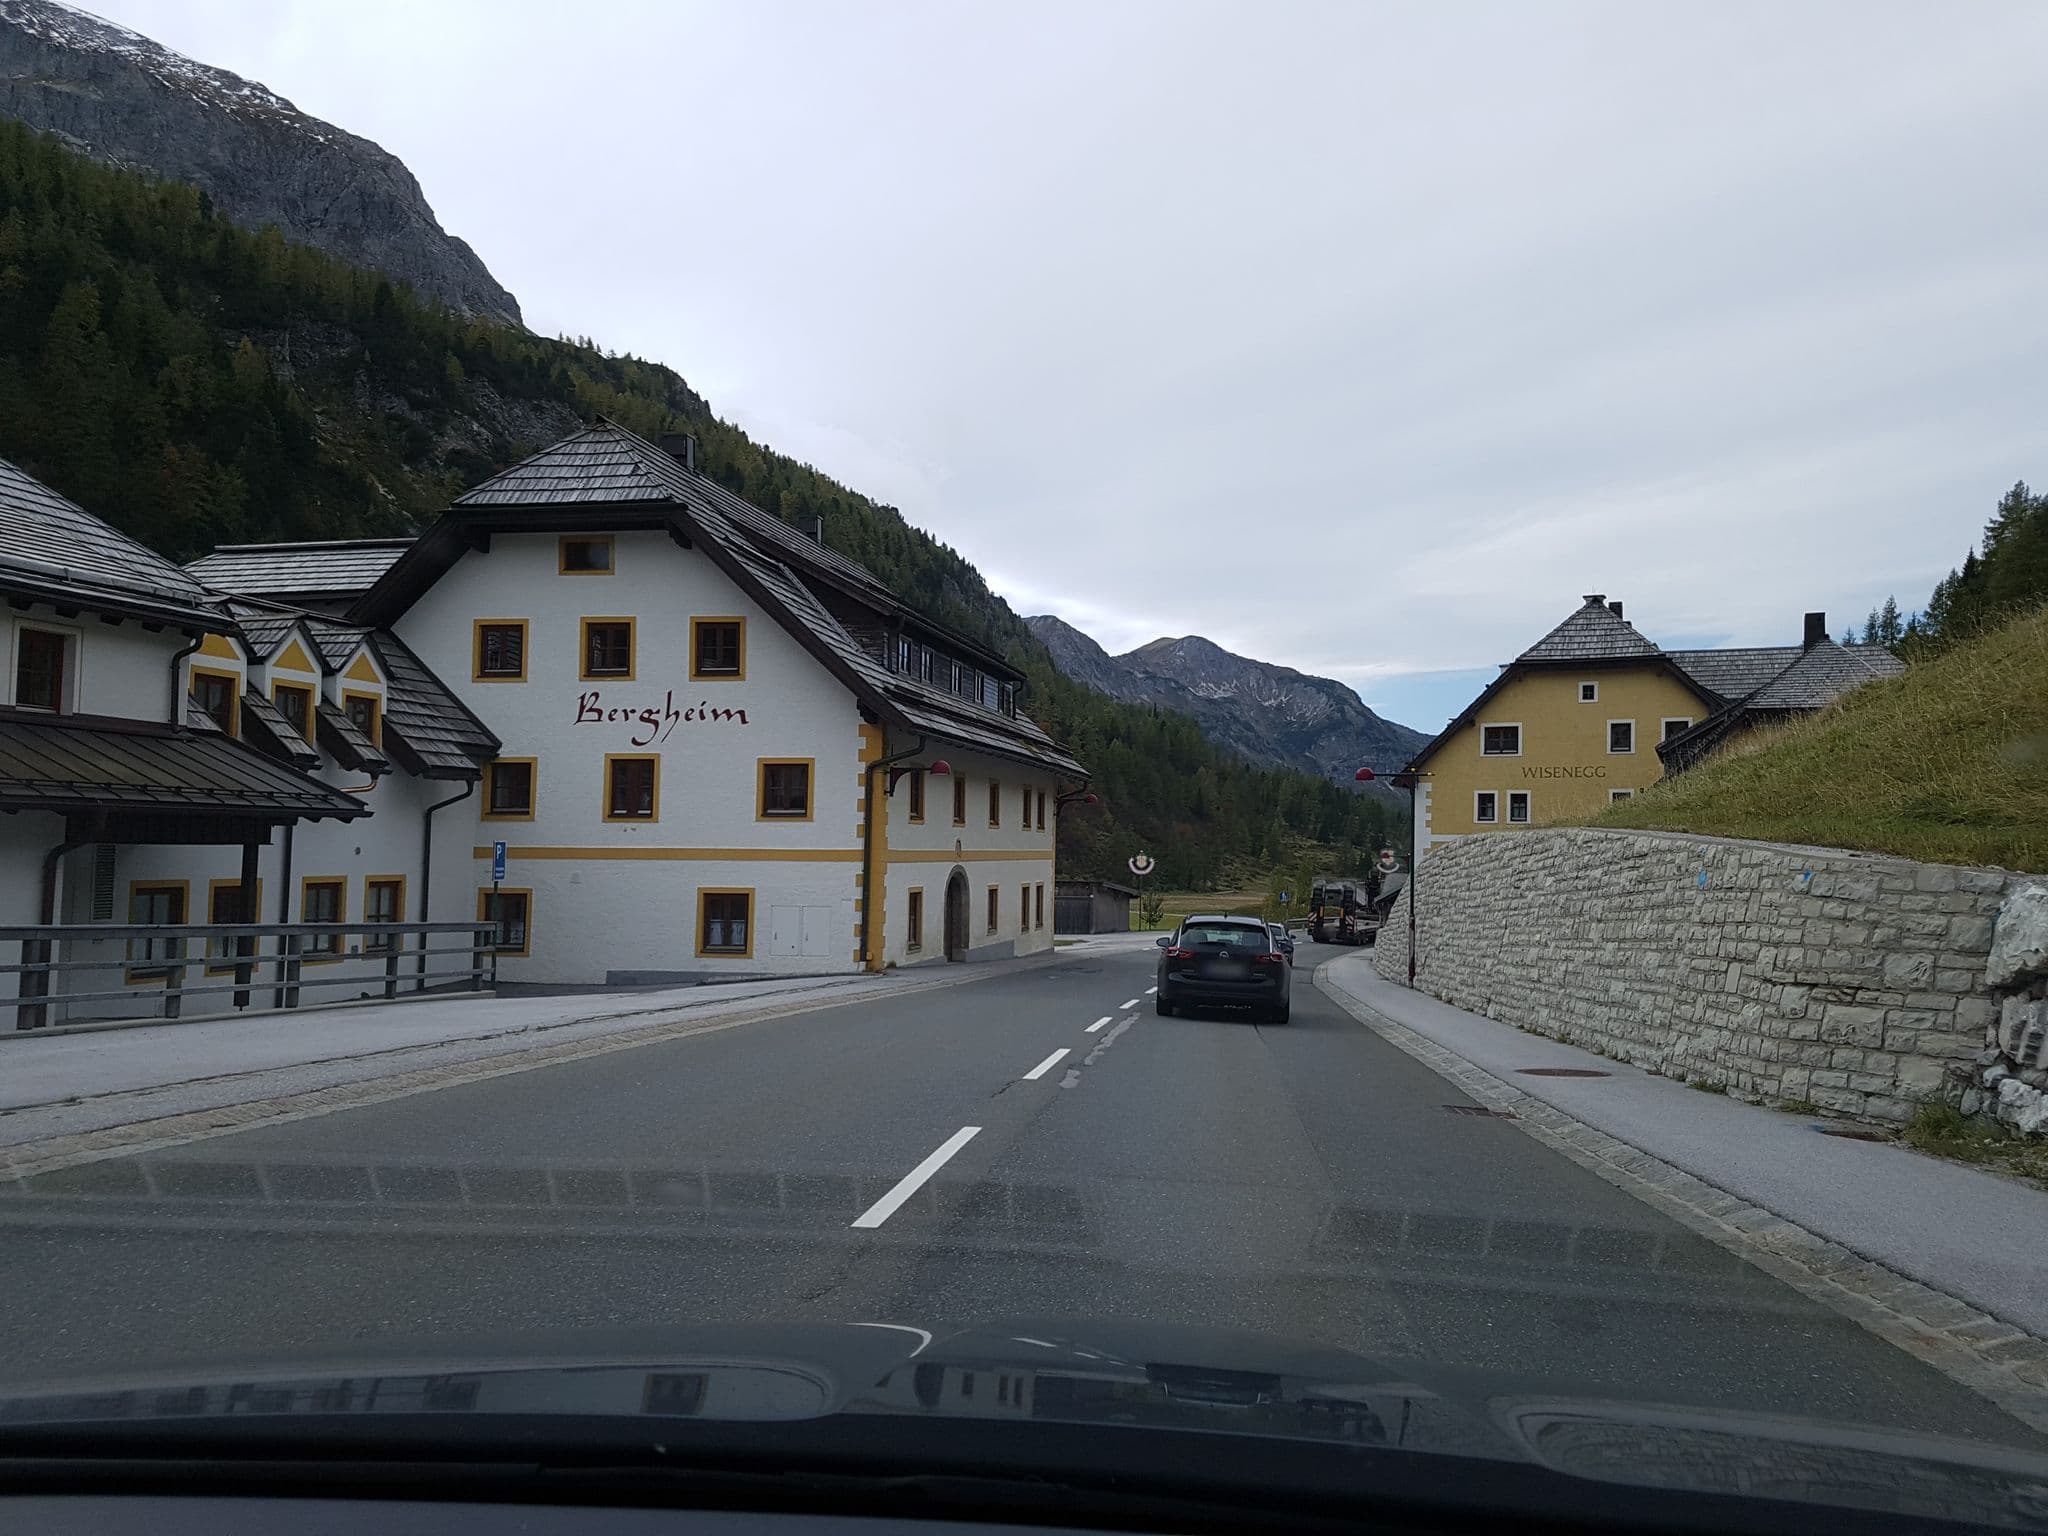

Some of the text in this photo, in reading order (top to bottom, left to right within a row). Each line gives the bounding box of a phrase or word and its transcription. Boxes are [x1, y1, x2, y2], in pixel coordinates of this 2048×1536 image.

[573, 690, 750, 747] Bergheim
[1522, 765, 1607, 779] WISENEGG
[496, 844, 502, 860] P
